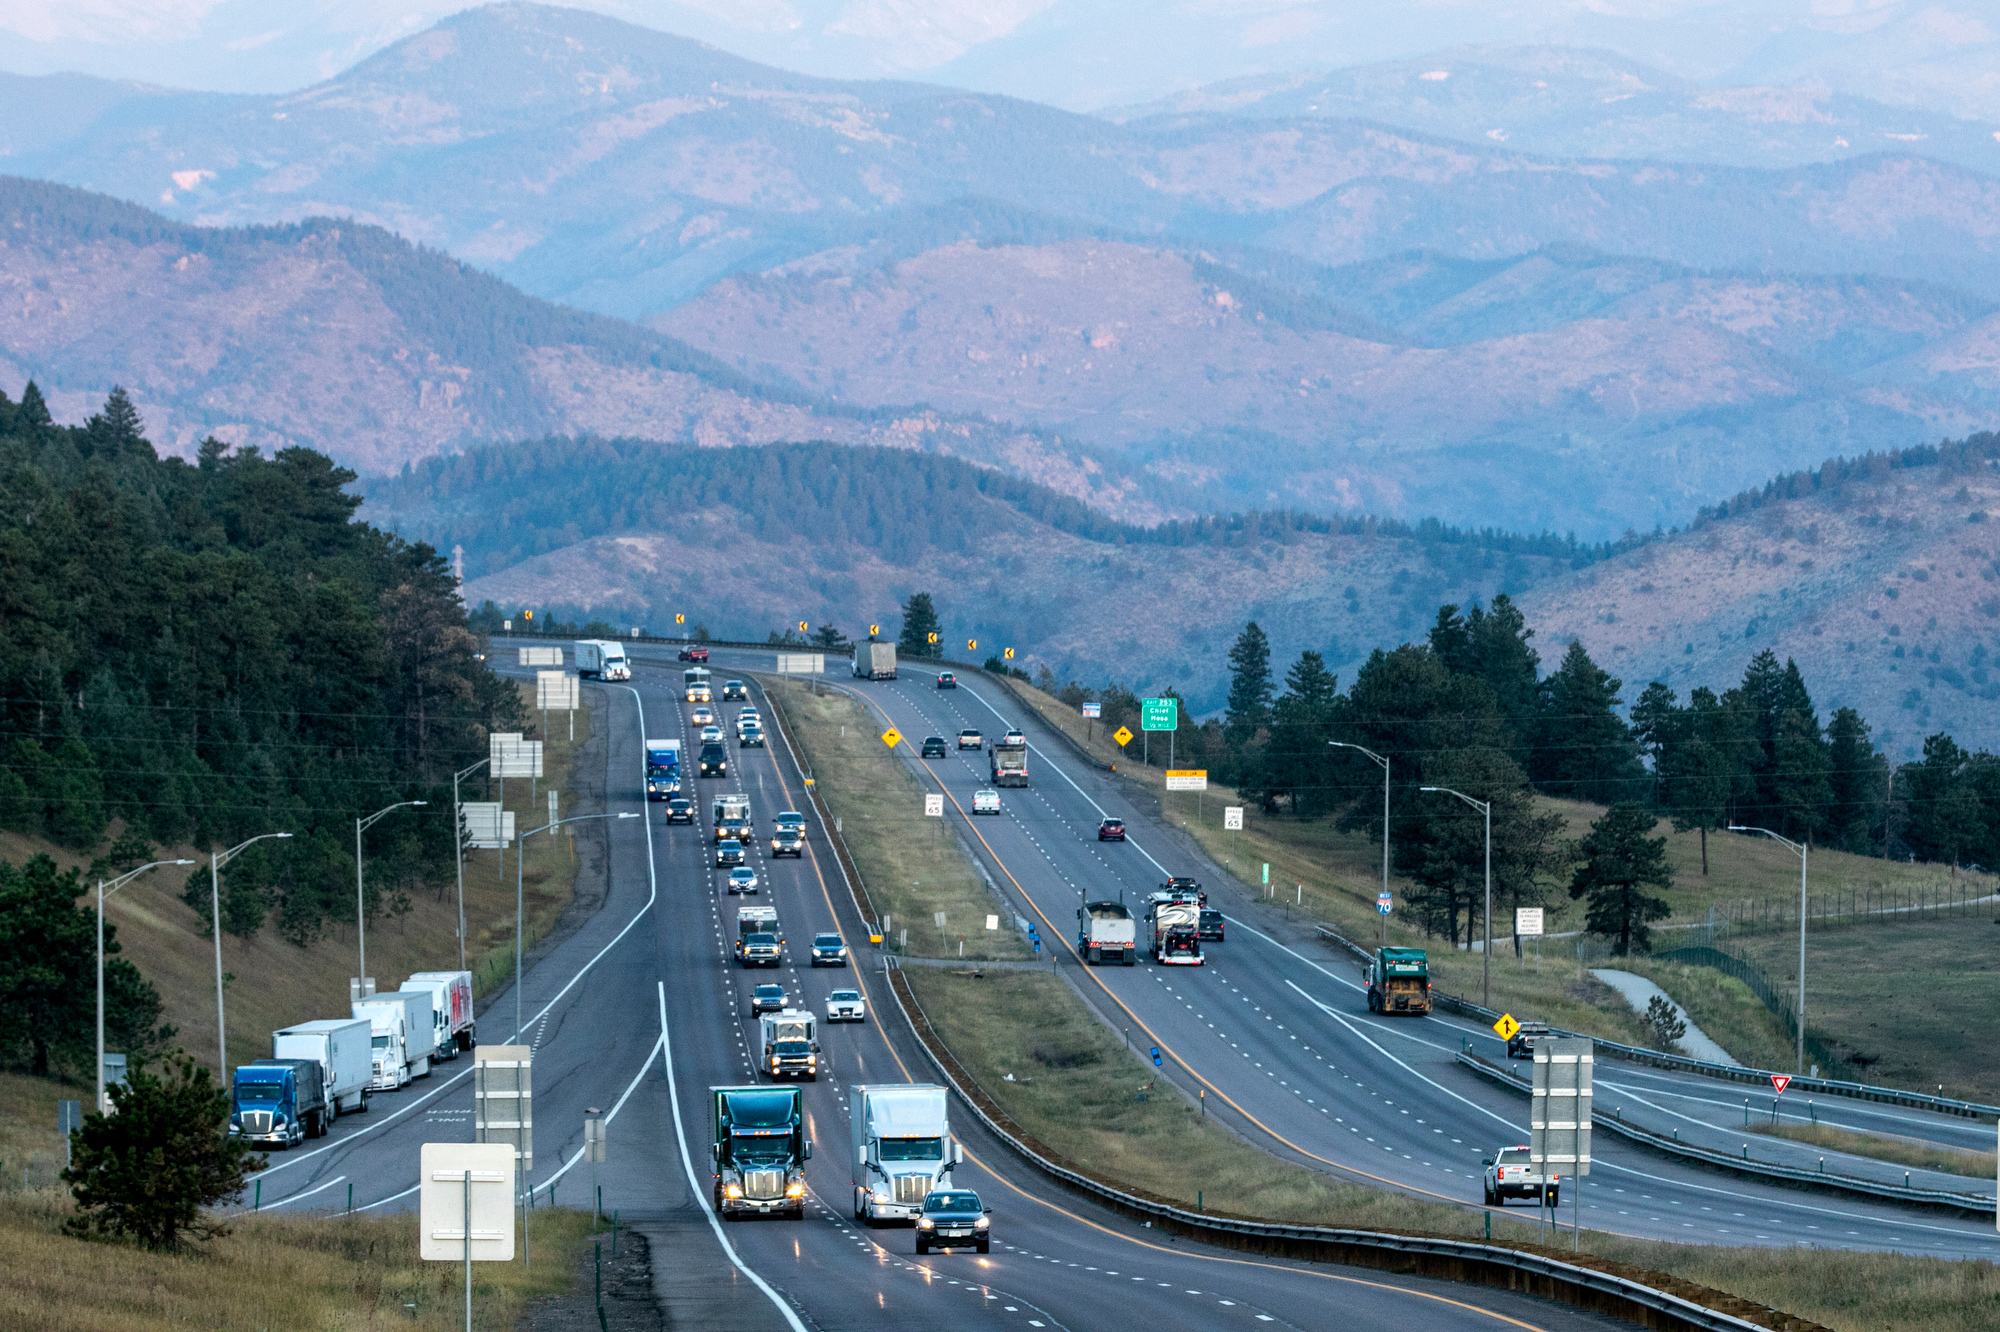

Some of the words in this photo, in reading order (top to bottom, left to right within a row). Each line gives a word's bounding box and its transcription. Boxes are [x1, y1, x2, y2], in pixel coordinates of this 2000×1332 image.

[928, 806, 940, 814] 65
[1228, 819, 1239, 827] 65
[1379, 903, 1391, 912] 70
